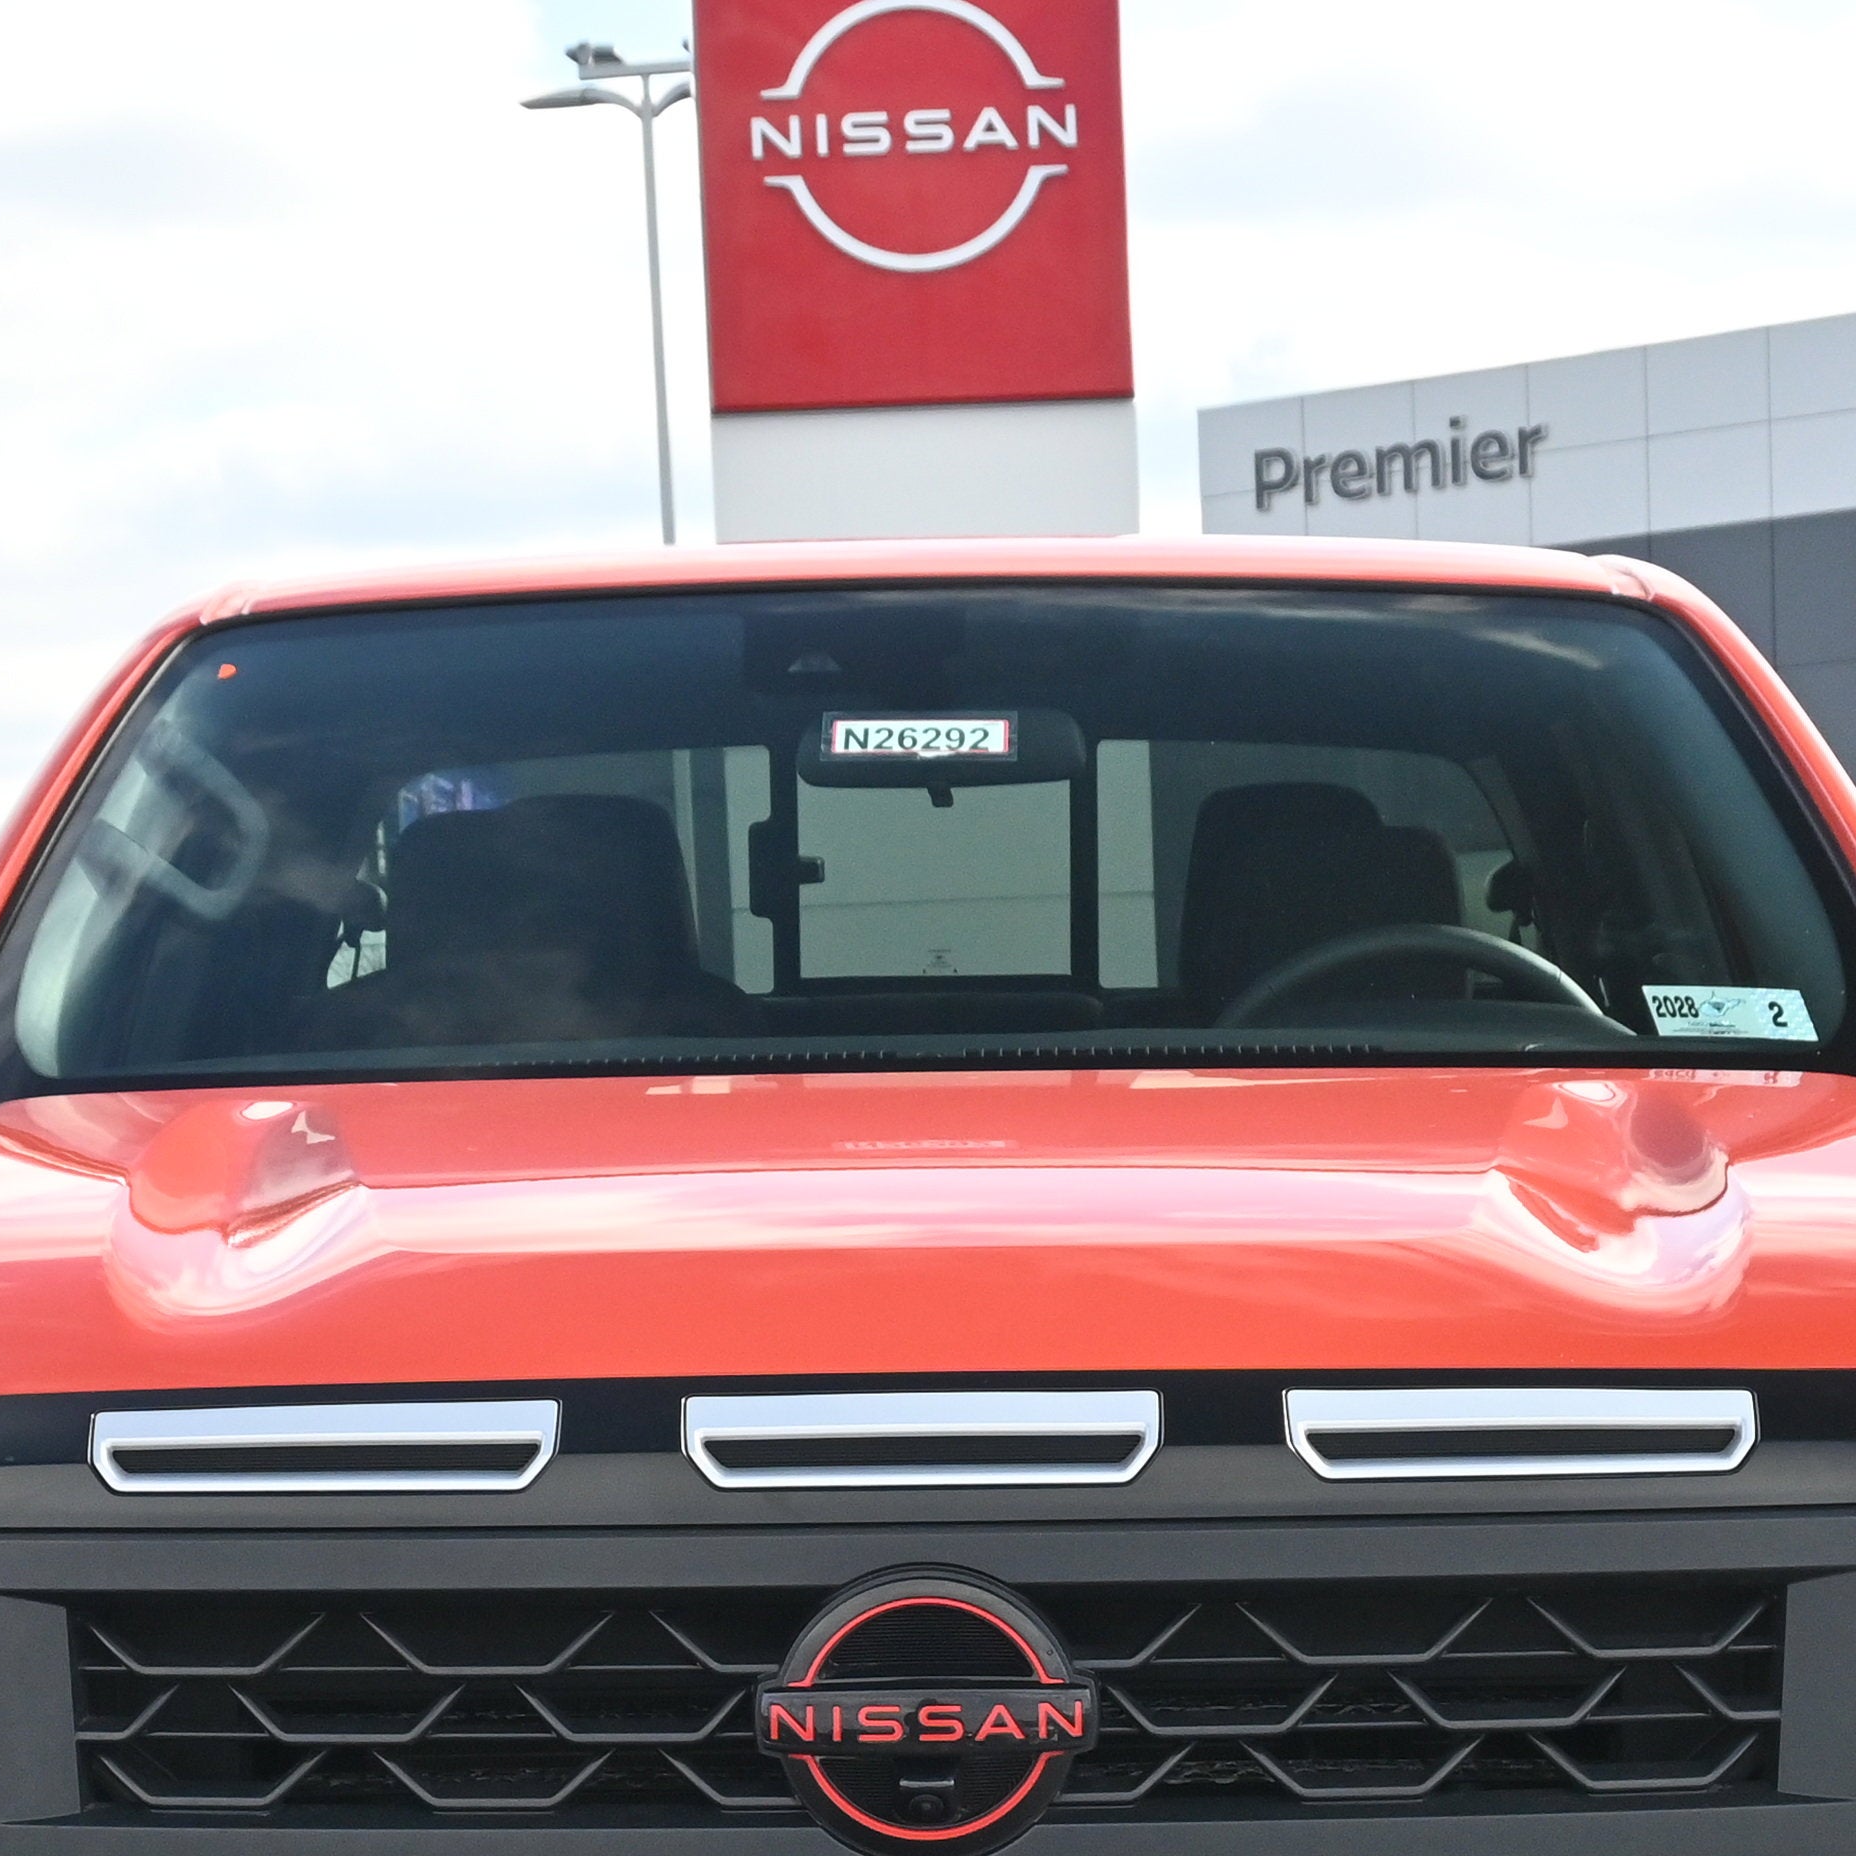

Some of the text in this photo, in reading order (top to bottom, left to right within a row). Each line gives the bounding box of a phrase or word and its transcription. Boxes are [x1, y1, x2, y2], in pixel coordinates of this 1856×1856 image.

[749, 103, 1078, 160] NISSAN
[1253, 415, 1549, 512] Premier
[843, 727, 991, 752] N26292
[1651, 995, 1788, 1027] 2028 2
[769, 1700, 1084, 1743] NISSAN
